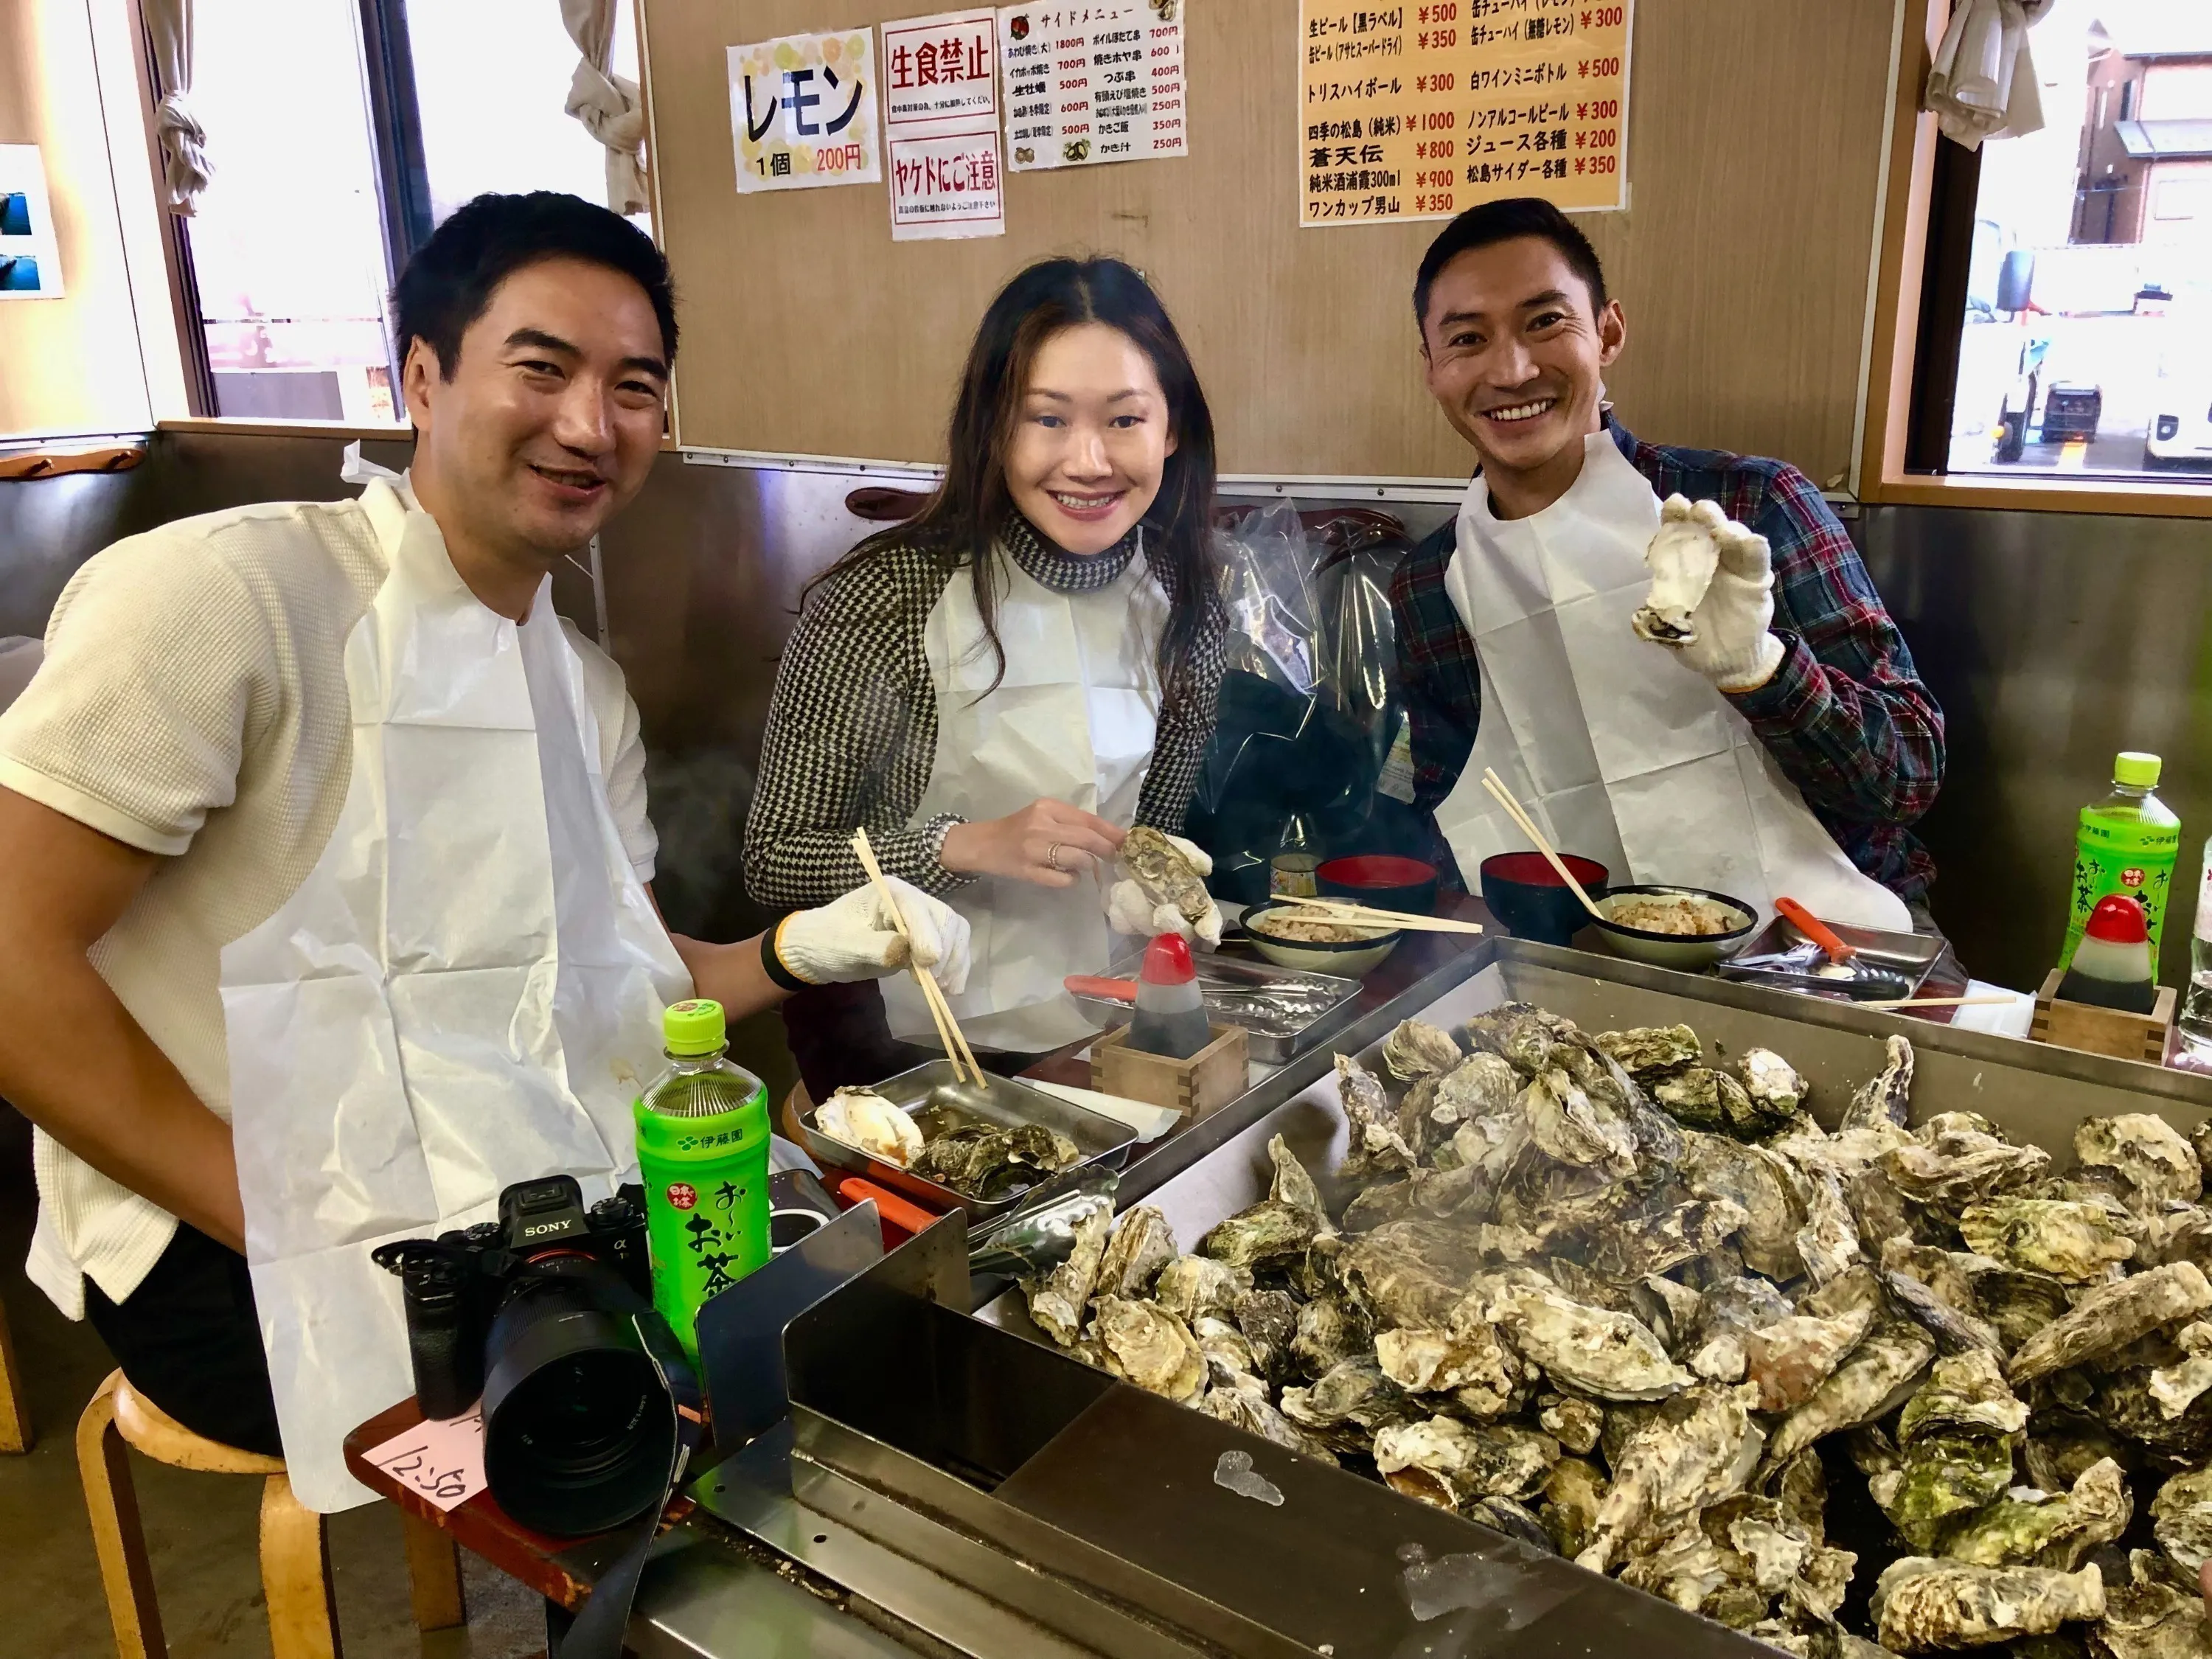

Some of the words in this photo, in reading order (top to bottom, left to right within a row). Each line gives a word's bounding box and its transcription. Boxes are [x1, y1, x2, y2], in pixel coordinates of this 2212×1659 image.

[1041, 8, 1133, 28] サイドメニュー
[1418, 2, 1457, 24] ¥500
[1580, 7, 1622, 29] ¥300
[1149, 26, 1178, 38] 700円
[1418, 29, 1456, 49] ¥350
[1056, 37, 1085, 49] 1800円
[891, 35, 990, 89] 生食禁止
[1057, 58, 1086, 70] 700円
[1093, 49, 1142, 66] 焼きホヤ串
[1103, 70, 1136, 83] つぶ串
[1151, 65, 1180, 77] 400円
[1578, 57, 1619, 79] ¥500
[1060, 78, 1088, 90] 500円
[1152, 83, 1180, 94] 500円
[1309, 77, 1402, 103] トリスハイボール
[1416, 73, 1455, 93] ¥300
[744, 65, 863, 143] レモン
[1060, 101, 1089, 113] 600円
[1152, 100, 1180, 111] 250円
[1405, 111, 1455, 132] ¥1000
[1467, 102, 1570, 130] ノンアルコールビール
[1576, 100, 1618, 120] ¥300
[1062, 124, 1090, 135] 500円
[1098, 121, 1130, 135] かきご飯
[1152, 119, 1181, 131] 350円
[1100, 142, 1132, 153] かき汁
[1153, 137, 1182, 149] 250円
[1466, 128, 1568, 156] ジュース各種
[1575, 128, 1616, 149] ¥200
[757, 153, 791, 177] 1個
[816, 144, 861, 172] 200円
[1309, 145, 1384, 168] 蒼天伝
[1416, 140, 1454, 159] ¥800
[895, 150, 996, 197] ヤケドにご注意
[1416, 170, 1454, 188] ¥900
[1467, 157, 1568, 184] 松島サイダー各種
[1574, 155, 1615, 175] ¥350
[1309, 195, 1400, 218] ワンカップ男山
[1415, 193, 1453, 212] ¥350
[700, 1127, 743, 1149] 伊藤園
[525, 1219, 572, 1237] SONY
[685, 1212, 740, 1299] お茶
